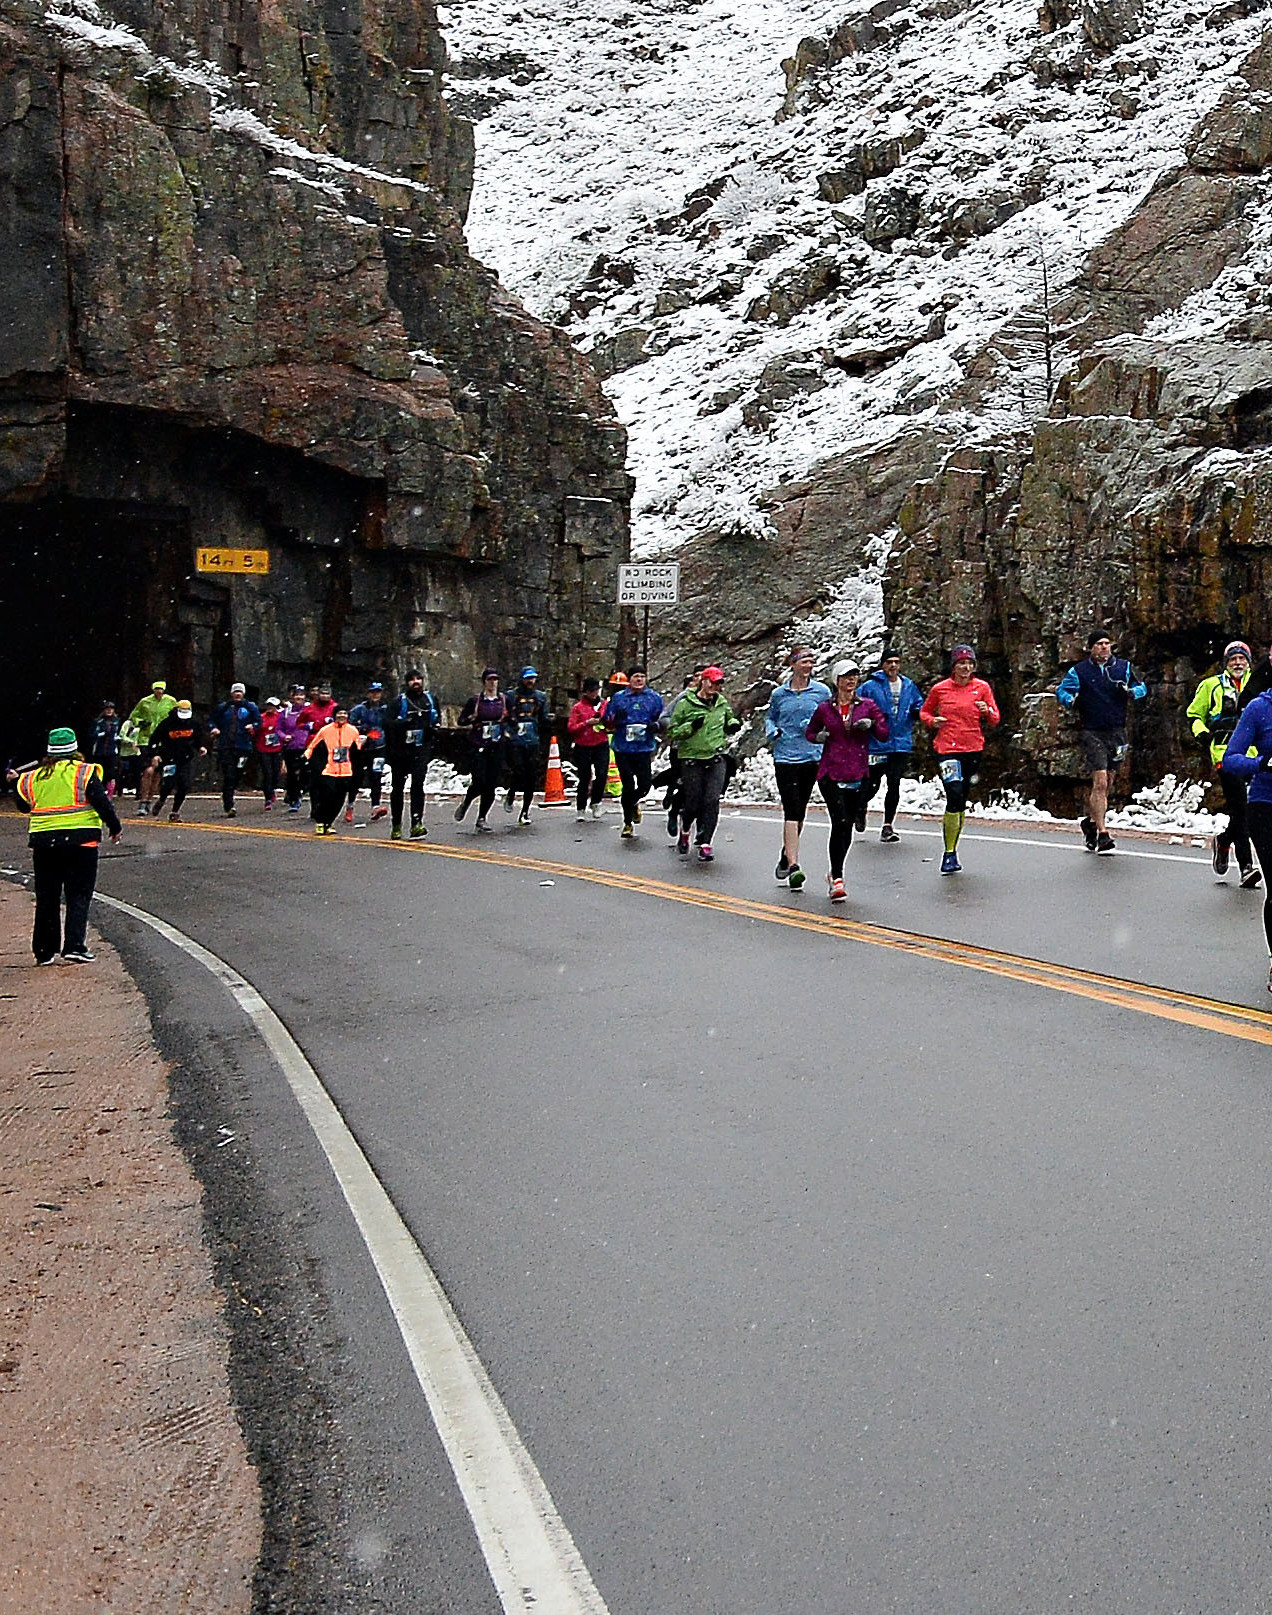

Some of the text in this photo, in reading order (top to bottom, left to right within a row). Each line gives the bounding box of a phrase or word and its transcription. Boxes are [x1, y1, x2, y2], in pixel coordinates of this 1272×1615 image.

[202, 554, 221, 566] 14
[243, 556, 253, 568] 5
[625, 569, 672, 577] NO ROCK
[625, 581, 672, 589] CLIMBING
[622, 592, 675, 601] OR DIVING
